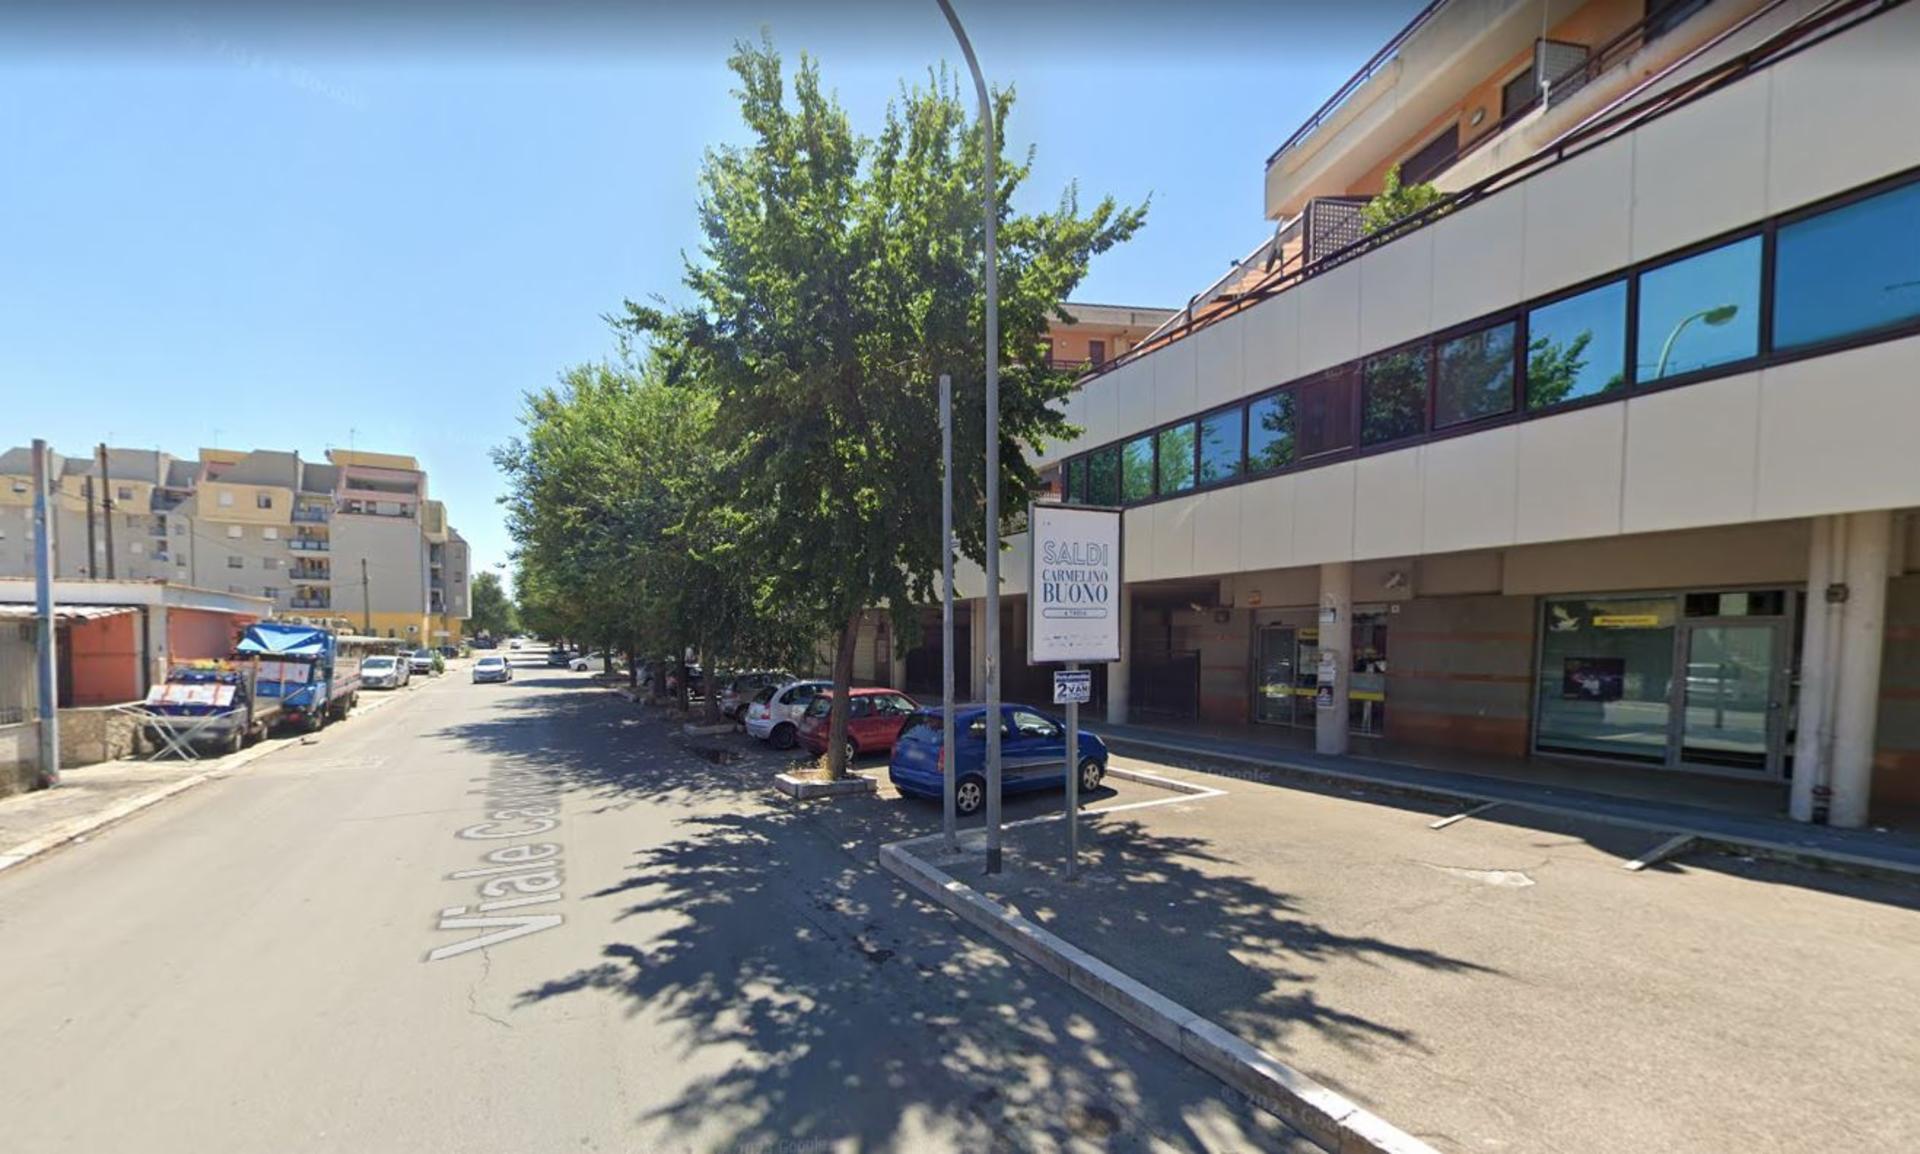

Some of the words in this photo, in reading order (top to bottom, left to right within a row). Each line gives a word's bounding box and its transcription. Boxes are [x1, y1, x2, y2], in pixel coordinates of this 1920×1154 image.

[1043, 540, 1108, 566] SALDI
[1042, 568, 1108, 583] CARMELINO
[1042, 583, 1108, 603] BUONO
[1057, 683, 1067, 698] 2
